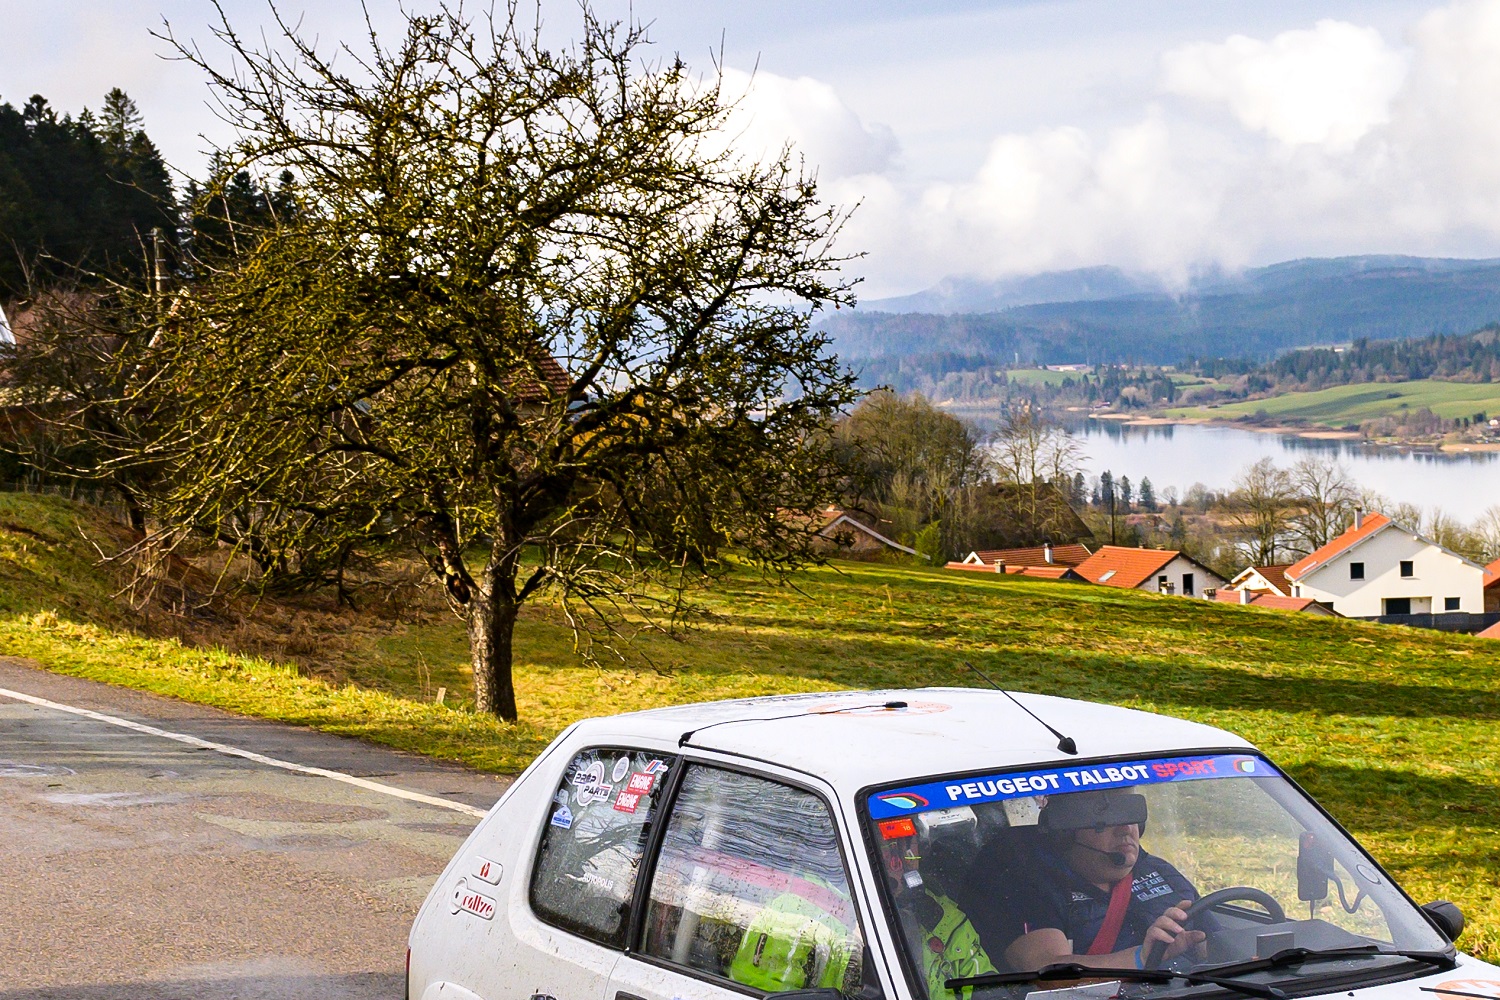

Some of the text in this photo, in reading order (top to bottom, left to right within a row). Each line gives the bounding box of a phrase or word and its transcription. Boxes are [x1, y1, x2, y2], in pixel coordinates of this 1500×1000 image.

[630, 773, 653, 790] ENGINE
[945, 758, 1217, 802] PEUGEOT TALBOT SPORT
[583, 785, 609, 797] PARTS
[617, 792, 639, 809] ENGINE
[582, 872, 614, 889] AUTOPOLIS
[462, 893, 493, 917] rallye
